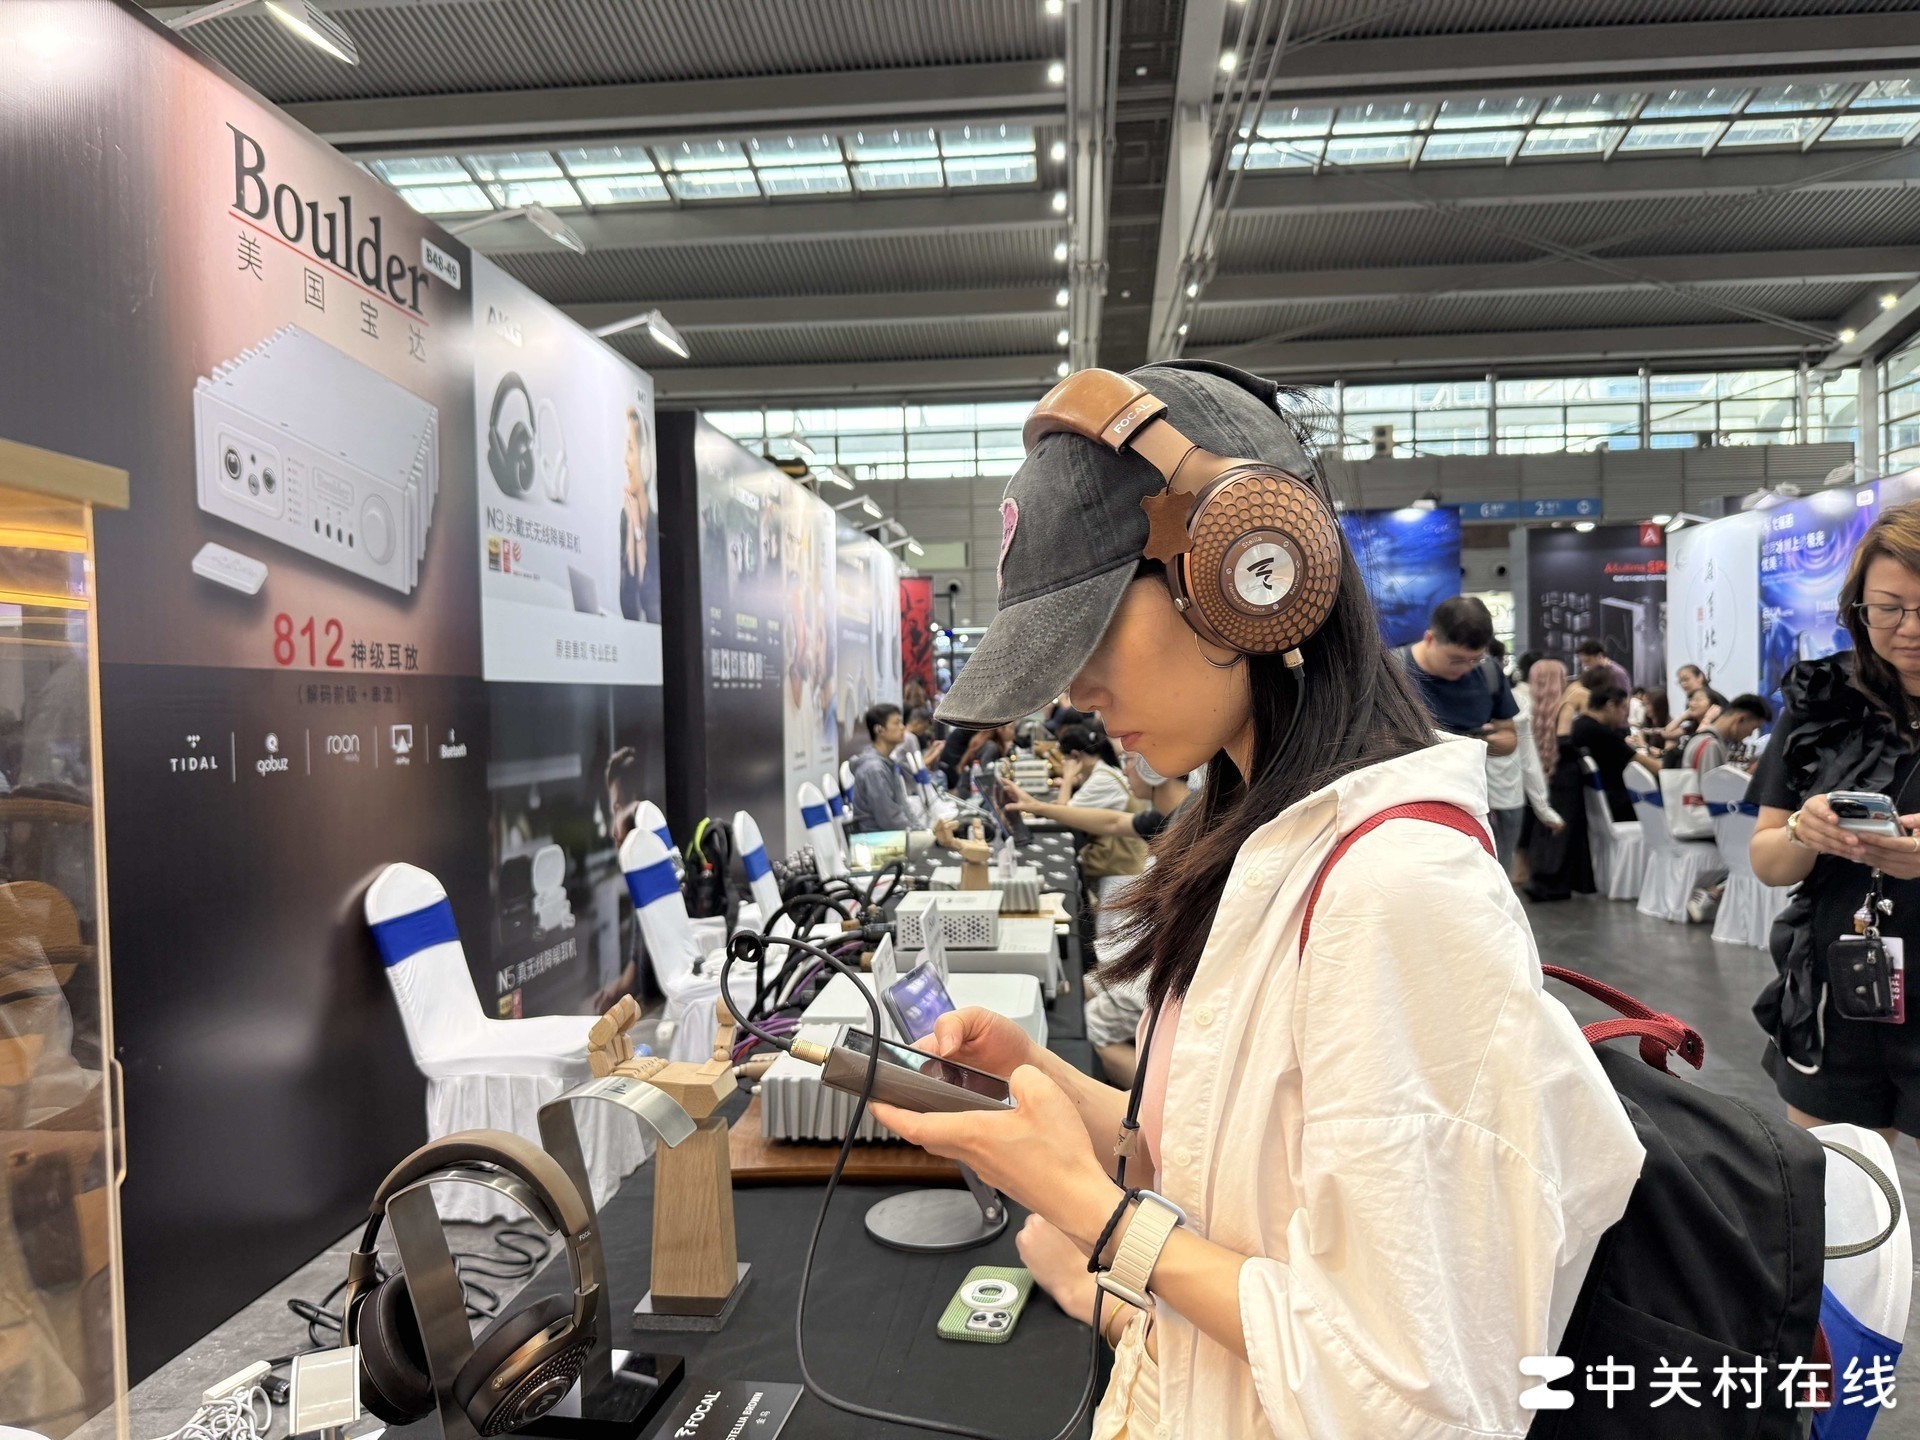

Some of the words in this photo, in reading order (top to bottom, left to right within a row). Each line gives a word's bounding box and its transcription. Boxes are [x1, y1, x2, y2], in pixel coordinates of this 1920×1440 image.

[226, 121, 429, 316] Boulder
[426, 246, 458, 281] B48-49
[237, 230, 426, 363] 美国宝达
[1113, 403, 1152, 433] FOCAL
[487, 506, 504, 532] N9
[1241, 536, 1263, 549] Stellia
[1247, 604, 1266, 613] France
[273, 611, 346, 668] 812
[351, 640, 419, 671] 神级耳放
[327, 735, 360, 755] roon
[169, 756, 219, 773] TIDAL
[256, 756, 289, 777] qobuz
[497, 965, 516, 995] N5
[684, 1390, 722, 1428] FOCAL
[742, 1391, 764, 1416] BROWN
